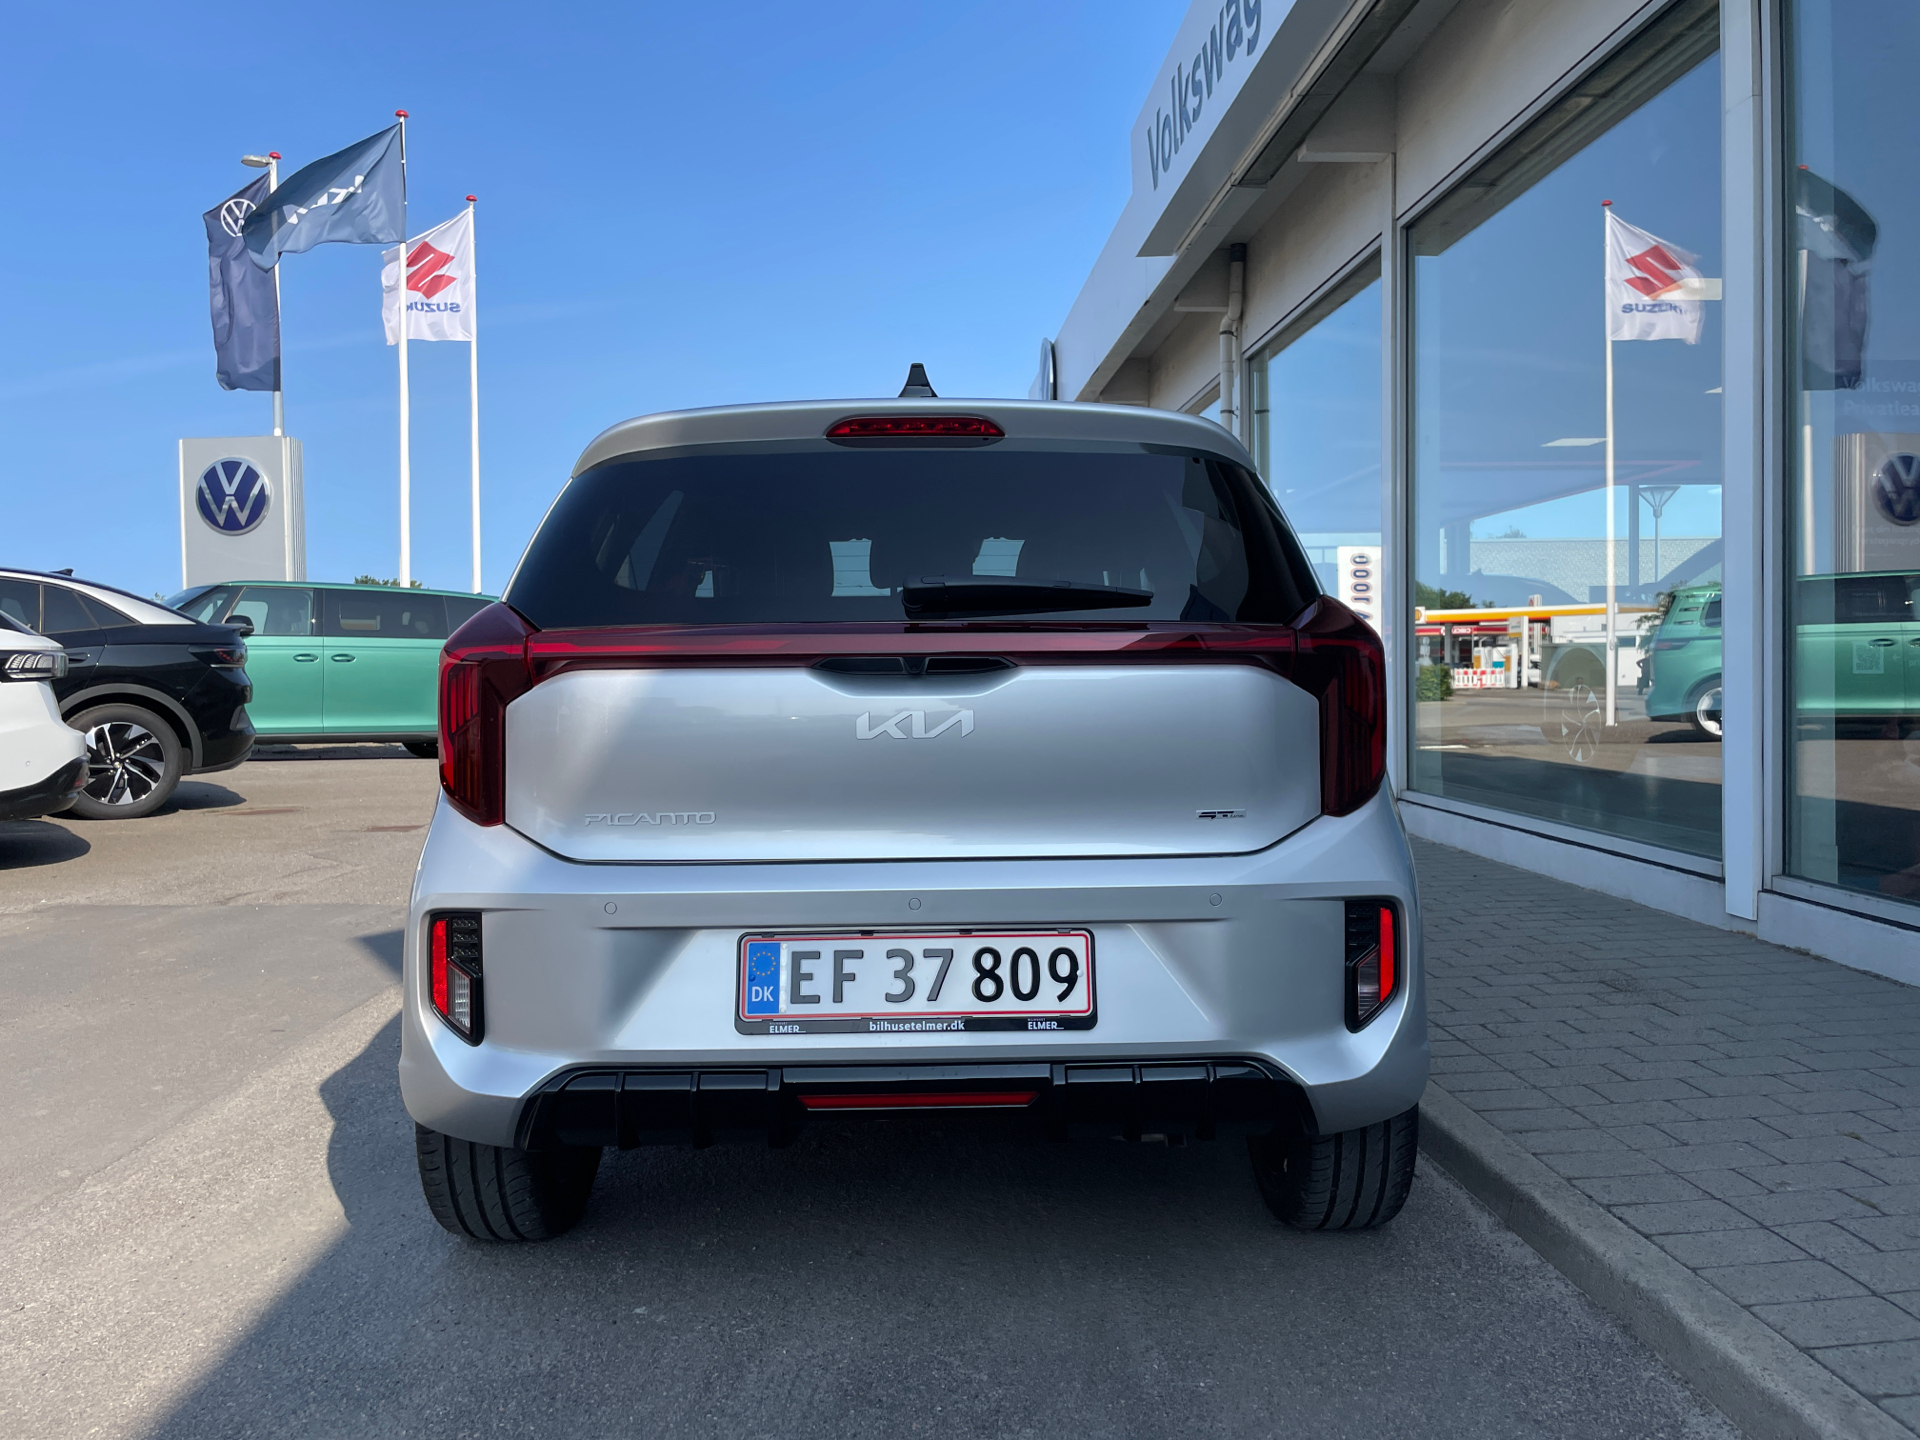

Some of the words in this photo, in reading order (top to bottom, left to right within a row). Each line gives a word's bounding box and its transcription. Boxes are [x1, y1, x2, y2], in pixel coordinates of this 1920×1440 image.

[855, 709, 975, 740] KIA
[584, 811, 717, 827] PICANTO
[790, 949, 863, 1005] EF
[885, 948, 955, 1003] 37
[972, 946, 1080, 1003] 809
[751, 986, 775, 1002] DK
[769, 1025, 800, 1034] ELMER
[869, 1020, 966, 1032] bilhusetelmer.dk
[1027, 1021, 1058, 1030] ELMER
